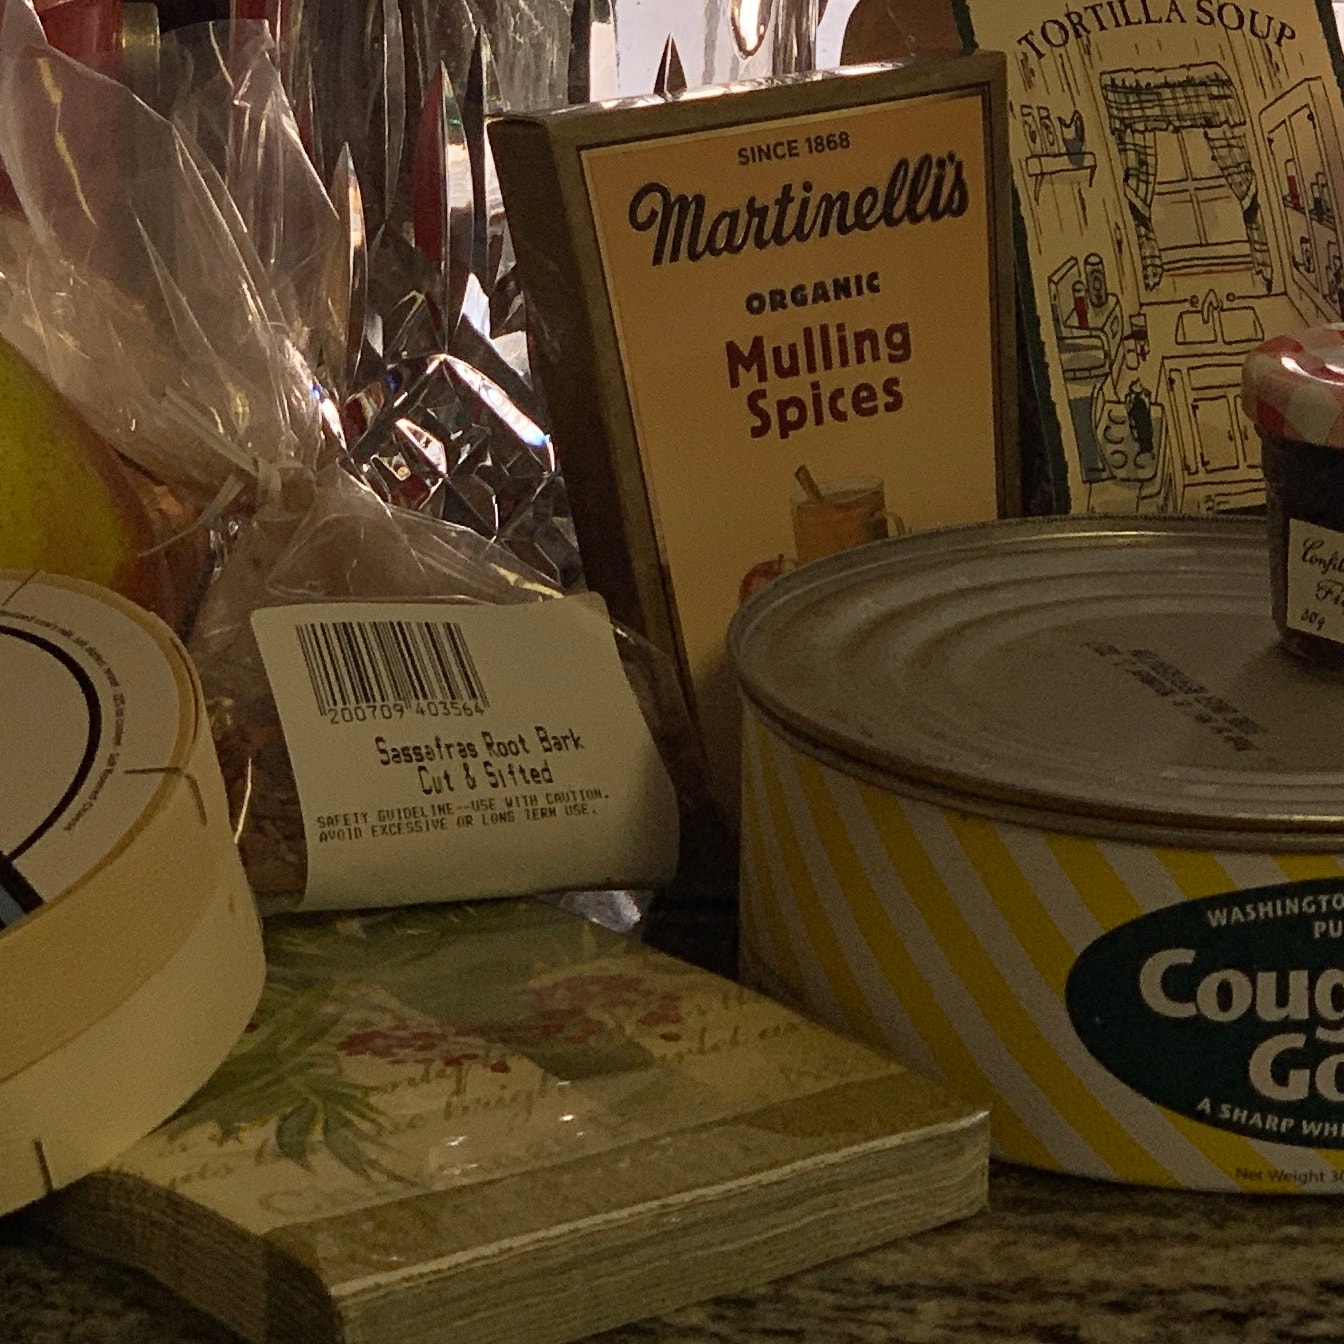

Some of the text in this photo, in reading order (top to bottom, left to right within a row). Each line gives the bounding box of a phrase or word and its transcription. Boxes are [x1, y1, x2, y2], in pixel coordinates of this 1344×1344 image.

[1196, 0, 1297, 47] SOUP
[738, 131, 851, 166] SINCE 1868
[628, 151, 969, 266] Martinelli's
[746, 271, 881, 316] ORGANIC
[725, 321, 912, 390] Mulling
[746, 377, 904, 440] Spices
[330, 700, 485, 725] 200709 403564
[375, 725, 585, 767] Sassafras Root Bark
[418, 759, 554, 796] Cut & Sifted
[317, 788, 610, 829] SAFETY WITH CAUTION.
[319, 801, 598, 844] AVOID EXCESSIVE OR LONG TERM USE.
[1196, 1097, 1212, 1115] A
[1216, 1102, 1295, 1134] SHARP
[1236, 1168, 1263, 1181] Net
[1268, 1169, 1324, 1186] Weight
